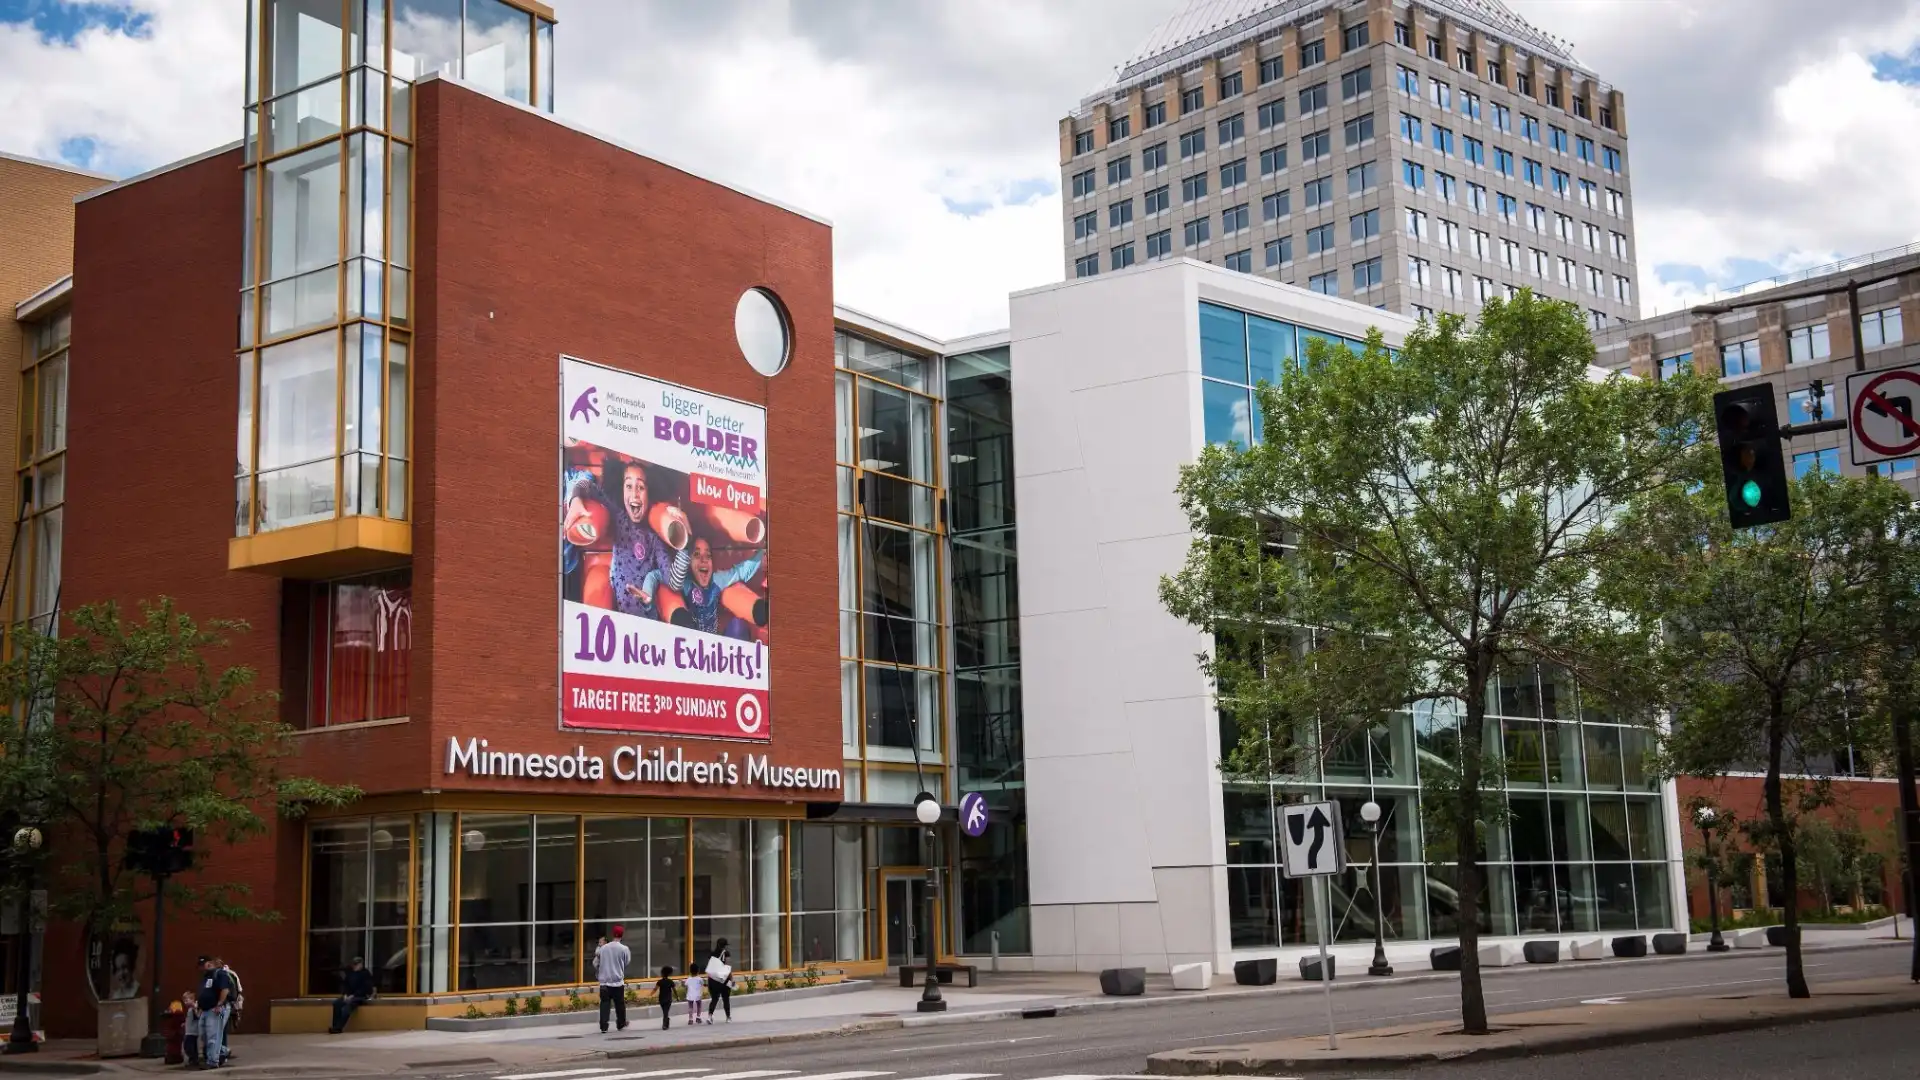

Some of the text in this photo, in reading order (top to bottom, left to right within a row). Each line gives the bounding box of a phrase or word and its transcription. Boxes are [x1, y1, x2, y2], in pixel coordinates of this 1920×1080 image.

[606, 392, 646, 409] Minnesota
[606, 407, 644, 423] Children's
[662, 390, 744, 433] bigger better
[606, 419, 639, 434] Museum
[653, 415, 758, 461] BOLDER
[697, 477, 755, 509] Now Open
[574, 612, 762, 680] 10 New Exhibits!
[572, 687, 727, 719] TARGET FREE 3RD SUNDAYS
[447, 736, 841, 790] Minnesota Children's Museum
